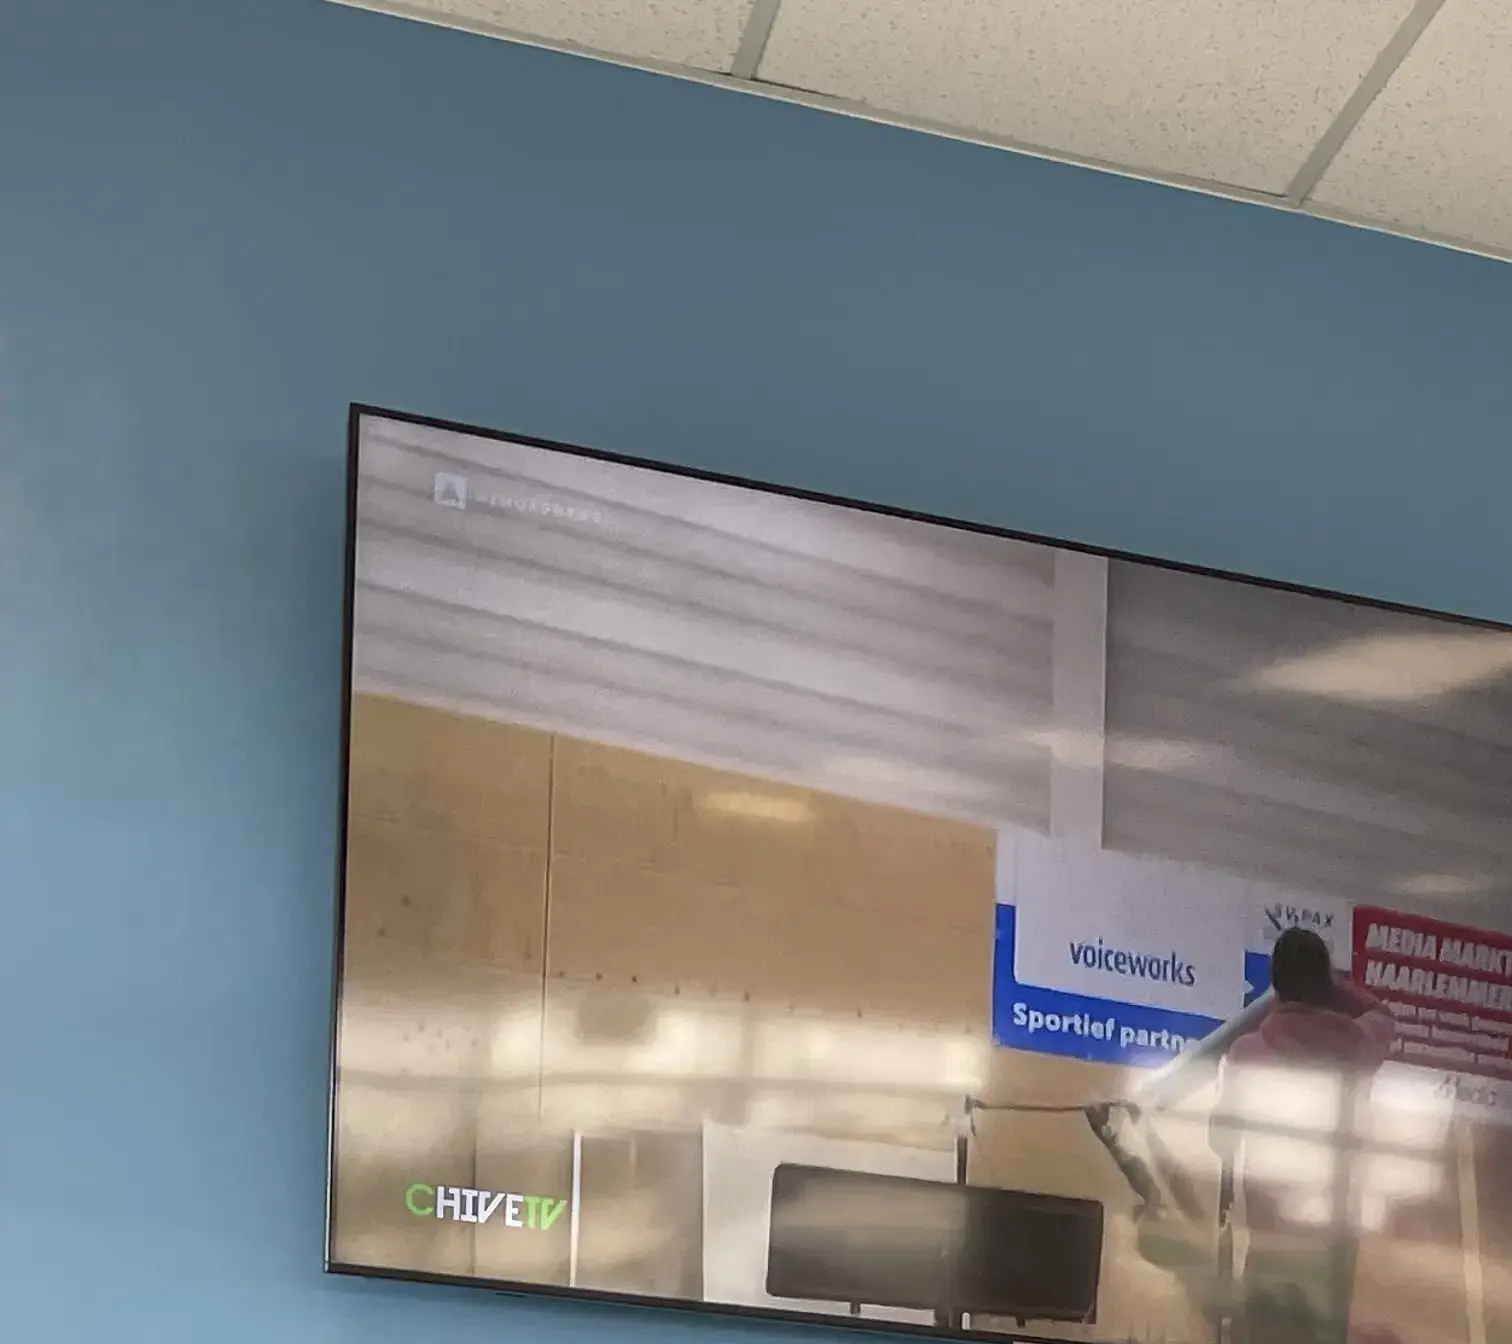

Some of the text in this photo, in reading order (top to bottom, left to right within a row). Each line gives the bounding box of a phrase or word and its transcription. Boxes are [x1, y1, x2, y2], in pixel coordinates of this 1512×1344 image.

[1364, 922, 1436, 960] MEDIA
[1069, 939, 1196, 987] voiceworks
[1012, 1002, 1115, 1041] Sportief
